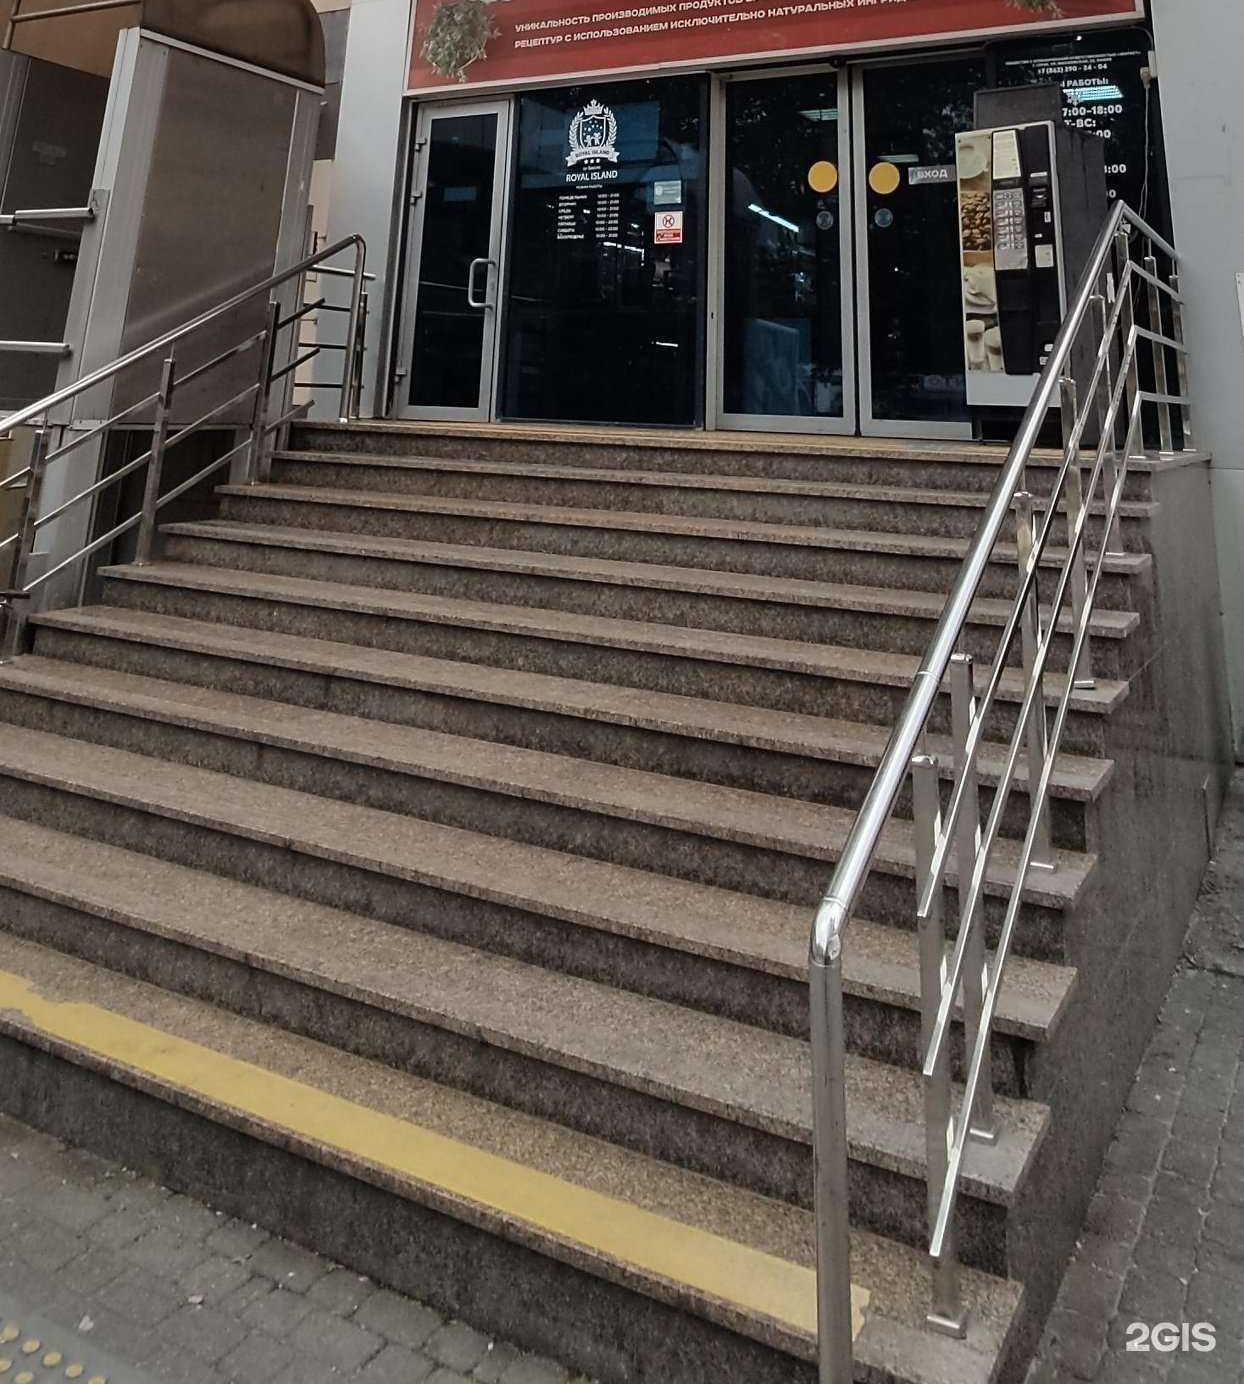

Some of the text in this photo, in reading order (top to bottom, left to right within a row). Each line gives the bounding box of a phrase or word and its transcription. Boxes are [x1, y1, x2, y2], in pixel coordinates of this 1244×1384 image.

[515, 16, 591, 33] УНИКАЛЬНОСТЬ
[592, 3, 676, 23] ПРОИЗВОДИМЫХ
[514, 35, 563, 49] РЕЦЕПТУР
[564, 33, 572, 42] С
[573, 22, 668, 41] ИСПОЛЬЗОВАНИЕМ
[670, 9, 765, 30] ИСКЛЮЧИТЕЛЬНО
[767, 0, 855, 19] НАТУРАЛЬНЫХ
[1066, 78, 1109, 87] РАБОТЫ:
[566, 170, 618, 182] ROYAL ISLAND
[917, 169, 948, 179] ВХОД
